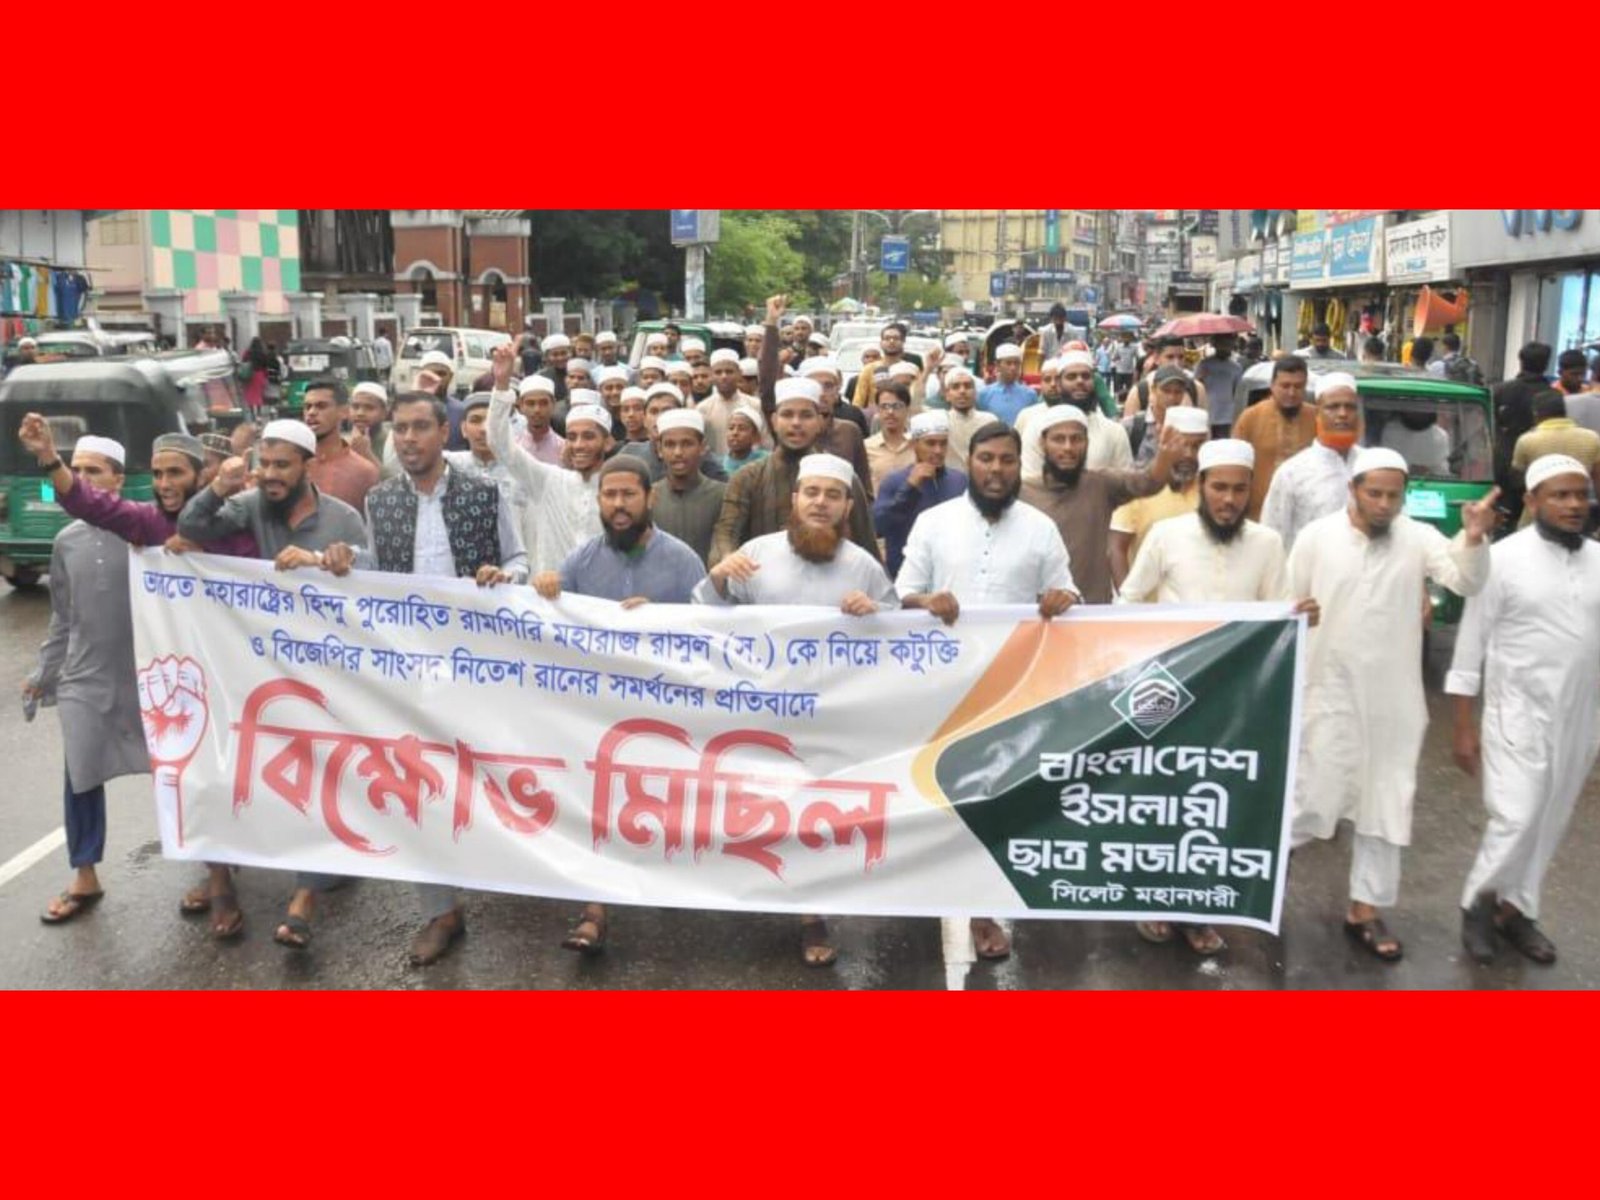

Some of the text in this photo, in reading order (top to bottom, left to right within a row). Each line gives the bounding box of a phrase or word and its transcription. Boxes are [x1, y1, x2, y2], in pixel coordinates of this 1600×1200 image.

[143, 571, 197, 598] ভাতে
[204, 578, 294, 614] মহারাষ্ট্রের
[300, 587, 348, 627] হিন্দু
[357, 596, 451, 632] পুরোহিত
[459, 608, 544, 643] রামগিরি
[553, 625, 640, 654] মহারাজ
[786, 639, 817, 665] কে
[827, 631, 880, 666] নিয়ে
[889, 631, 960, 673] কটুক্তি
[252, 630, 819, 717] ও বিজেপির সাংসদ নিতেশ রানের সমর্থনের প্রতিবাদে
[230, 678, 898, 883] বিক্ষোভ মিছিল
[1039, 745, 1258, 781] বাংলাদেশ
[1060, 782, 1229, 829] ইসলামী
[1008, 829, 1272, 880] ছাত্র মজলিস
[1050, 879, 1239, 908] সিলেট মহানগরী
